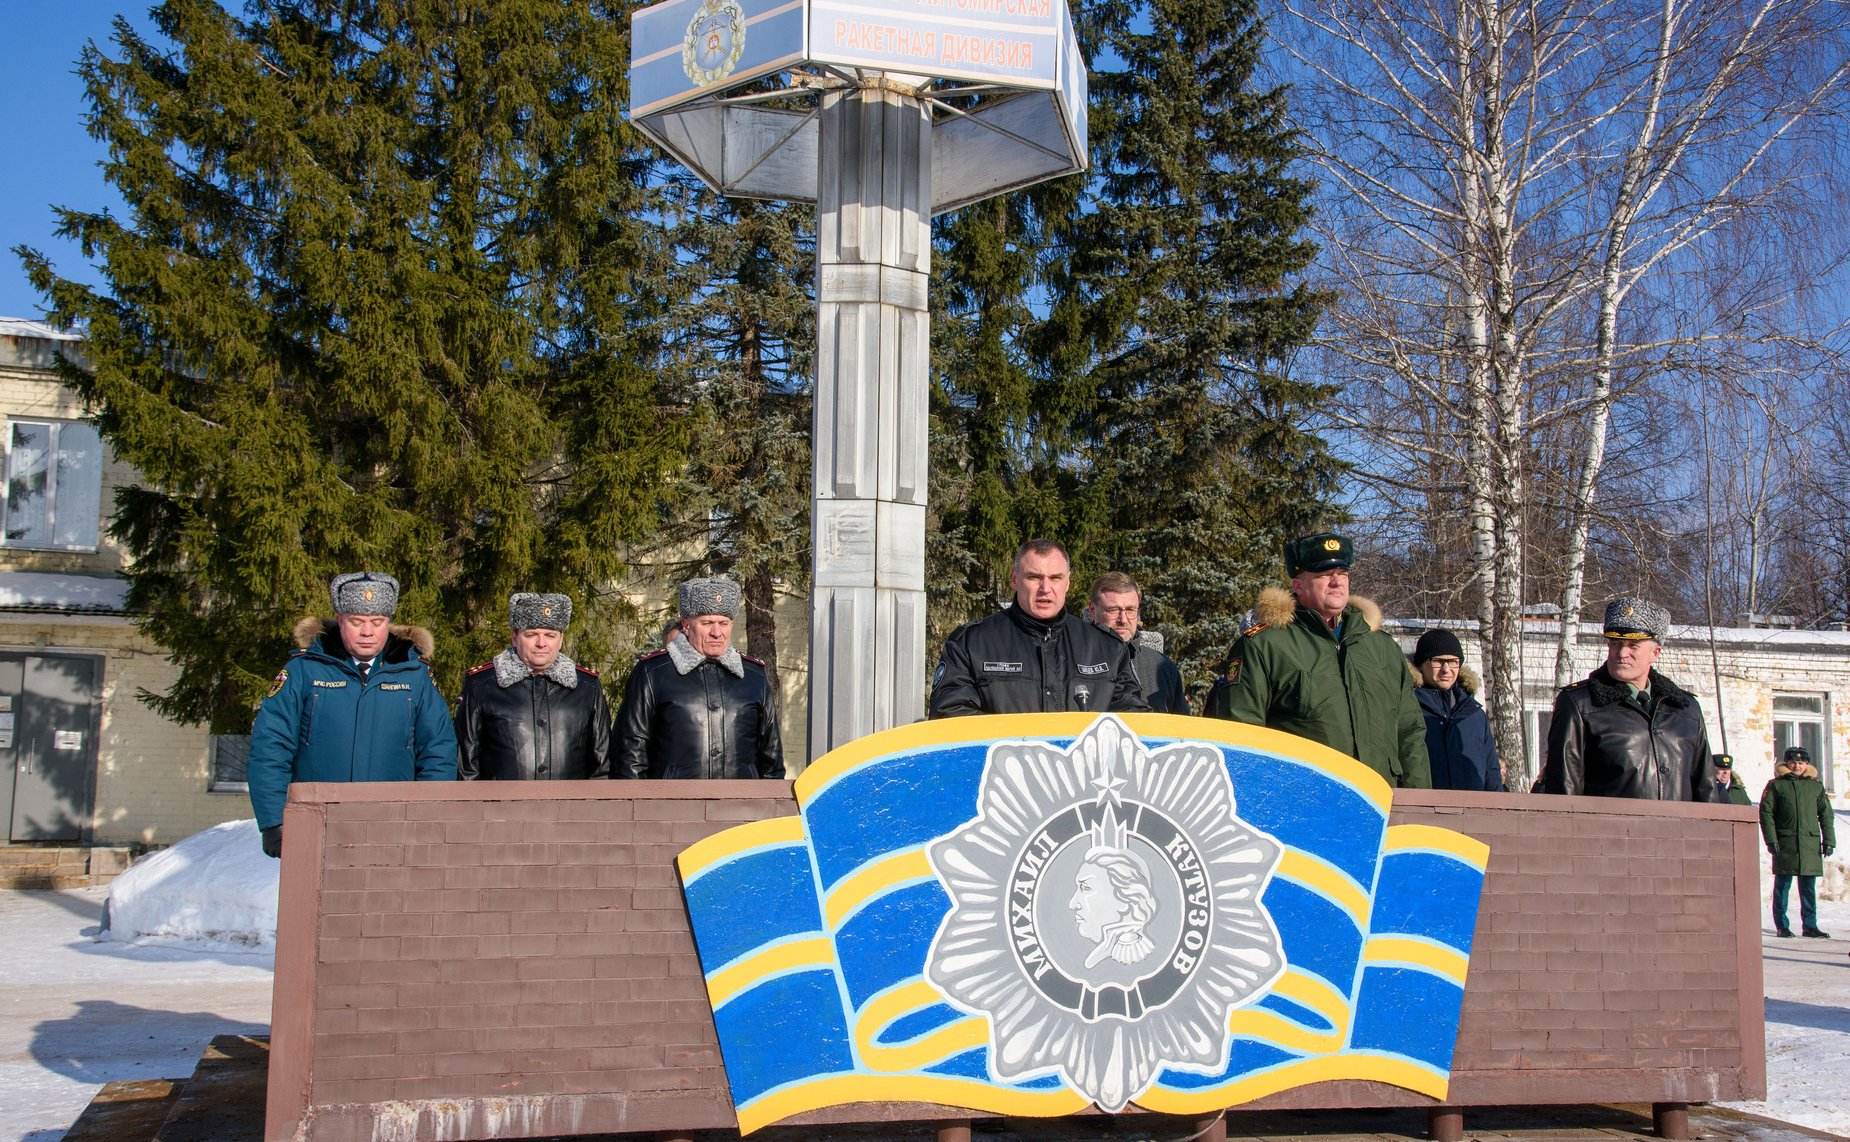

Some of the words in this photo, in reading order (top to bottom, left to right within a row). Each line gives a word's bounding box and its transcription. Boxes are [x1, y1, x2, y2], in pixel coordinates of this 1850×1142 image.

[834, 20, 936, 59] РАКЕТНАЯ
[941, 33, 1033, 70] ДИВИЗИЯ
[1012, 829, 1060, 981] МИХАИЛ
[1164, 832, 1209, 976] КУТУЗОВ
